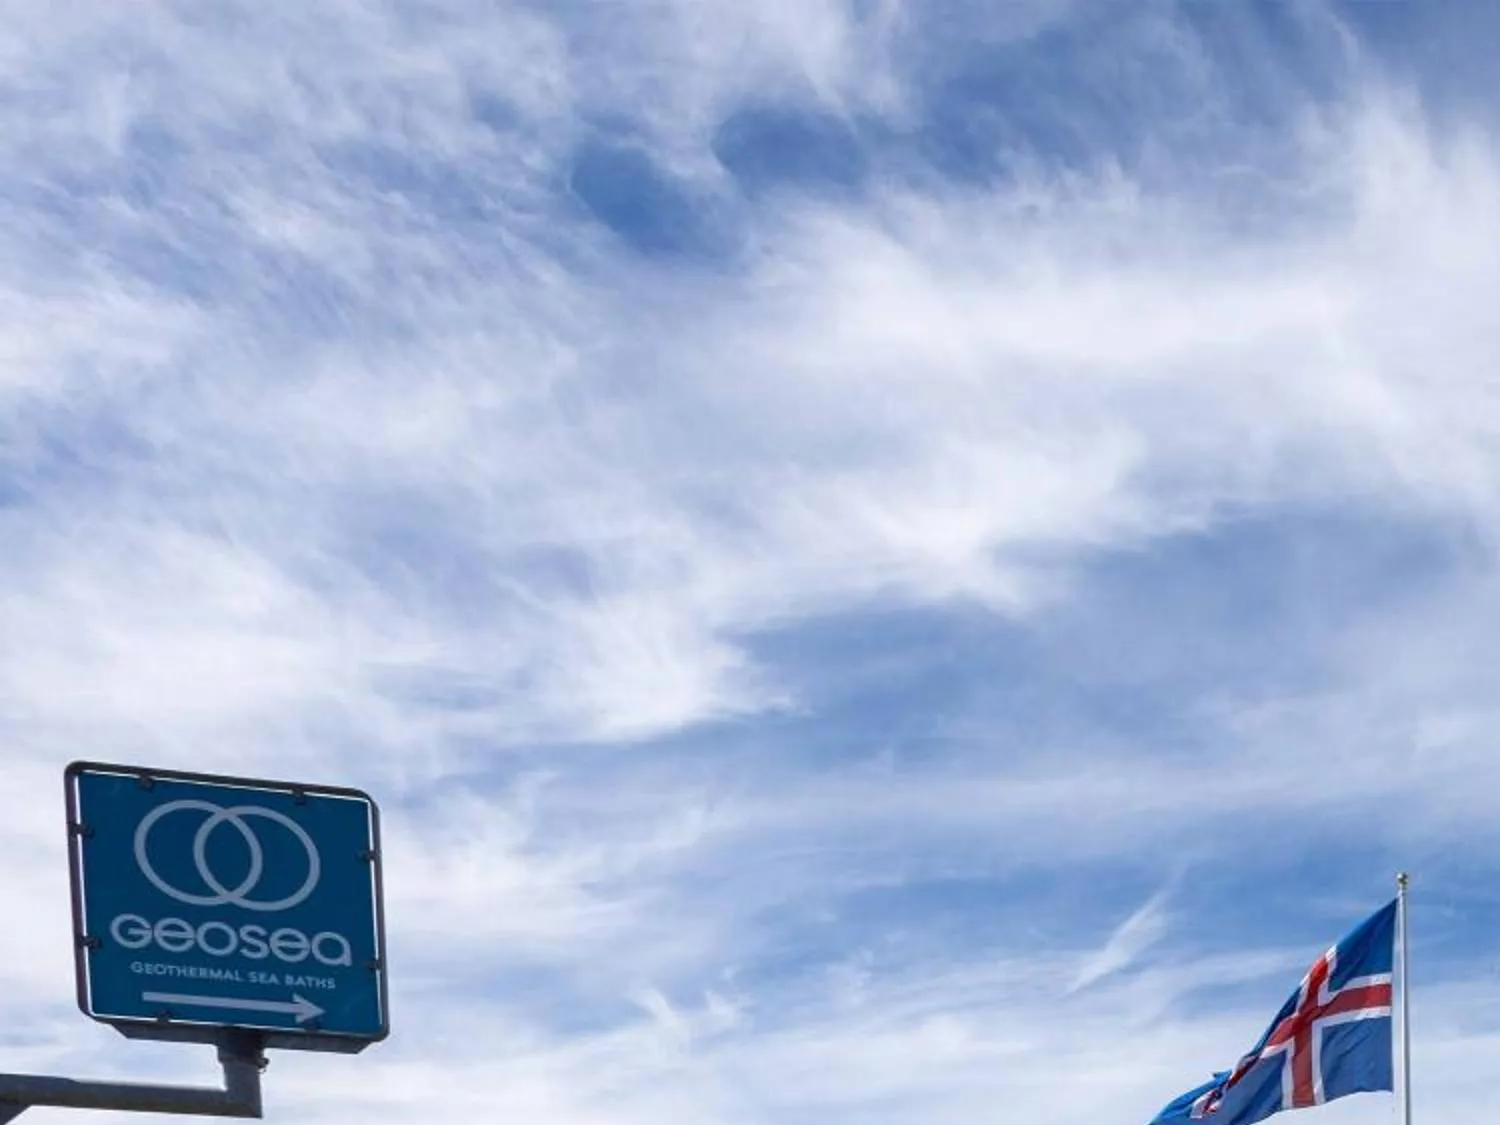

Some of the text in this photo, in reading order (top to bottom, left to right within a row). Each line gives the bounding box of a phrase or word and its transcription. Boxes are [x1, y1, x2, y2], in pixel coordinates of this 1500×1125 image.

[131, 961, 336, 989] GEOTHERMAL SEA BATHS
